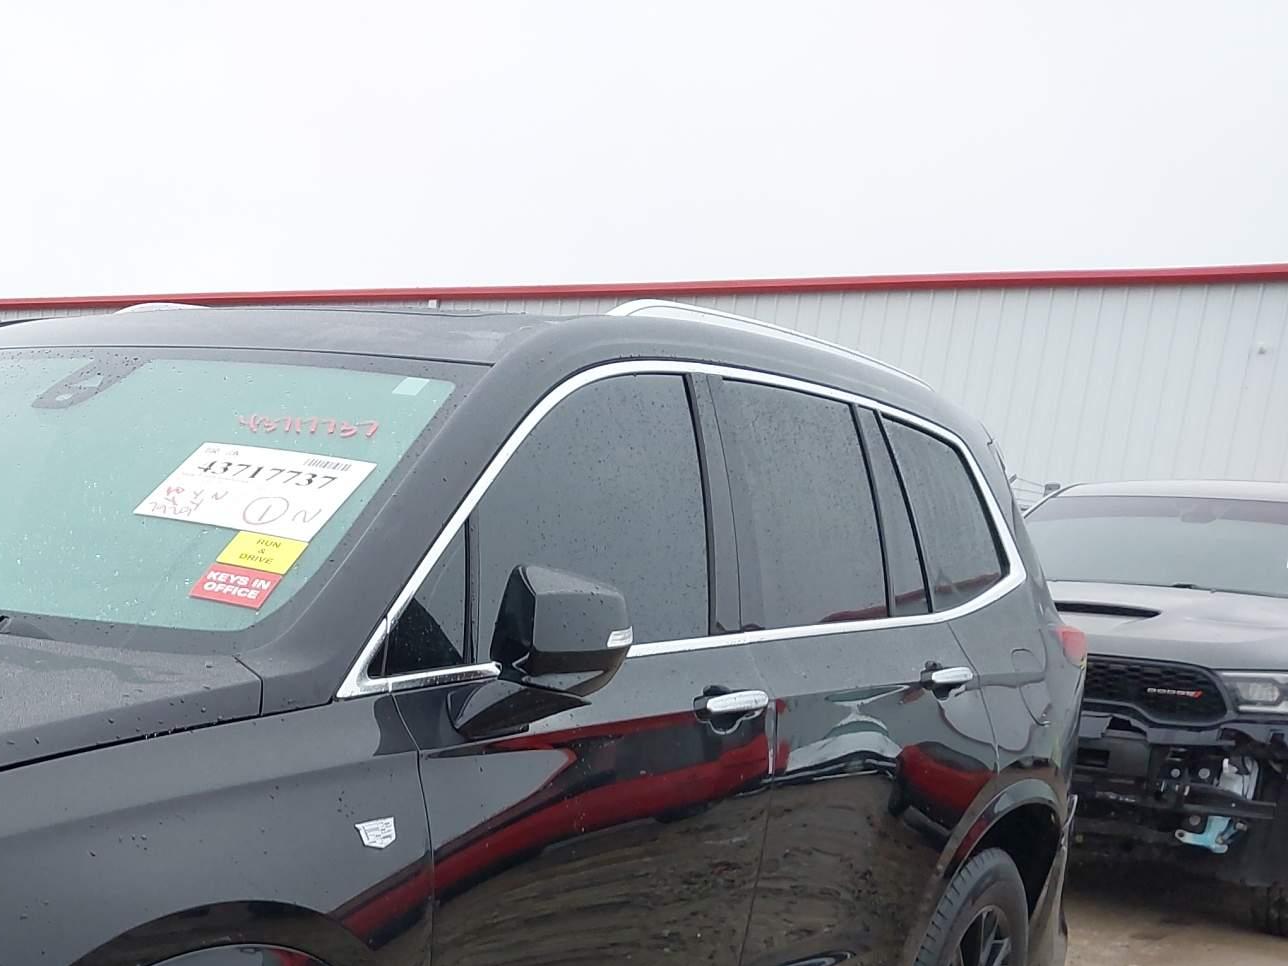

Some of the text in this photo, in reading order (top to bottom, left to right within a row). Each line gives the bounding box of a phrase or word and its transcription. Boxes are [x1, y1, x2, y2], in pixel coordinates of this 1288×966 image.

[197, 460, 338, 489] 43717737
[256, 539, 282, 549] RUN
[238, 553, 274, 565] DRIVE
[203, 581, 261, 600] OFFICE
[206, 571, 272, 591] KEYS IN
